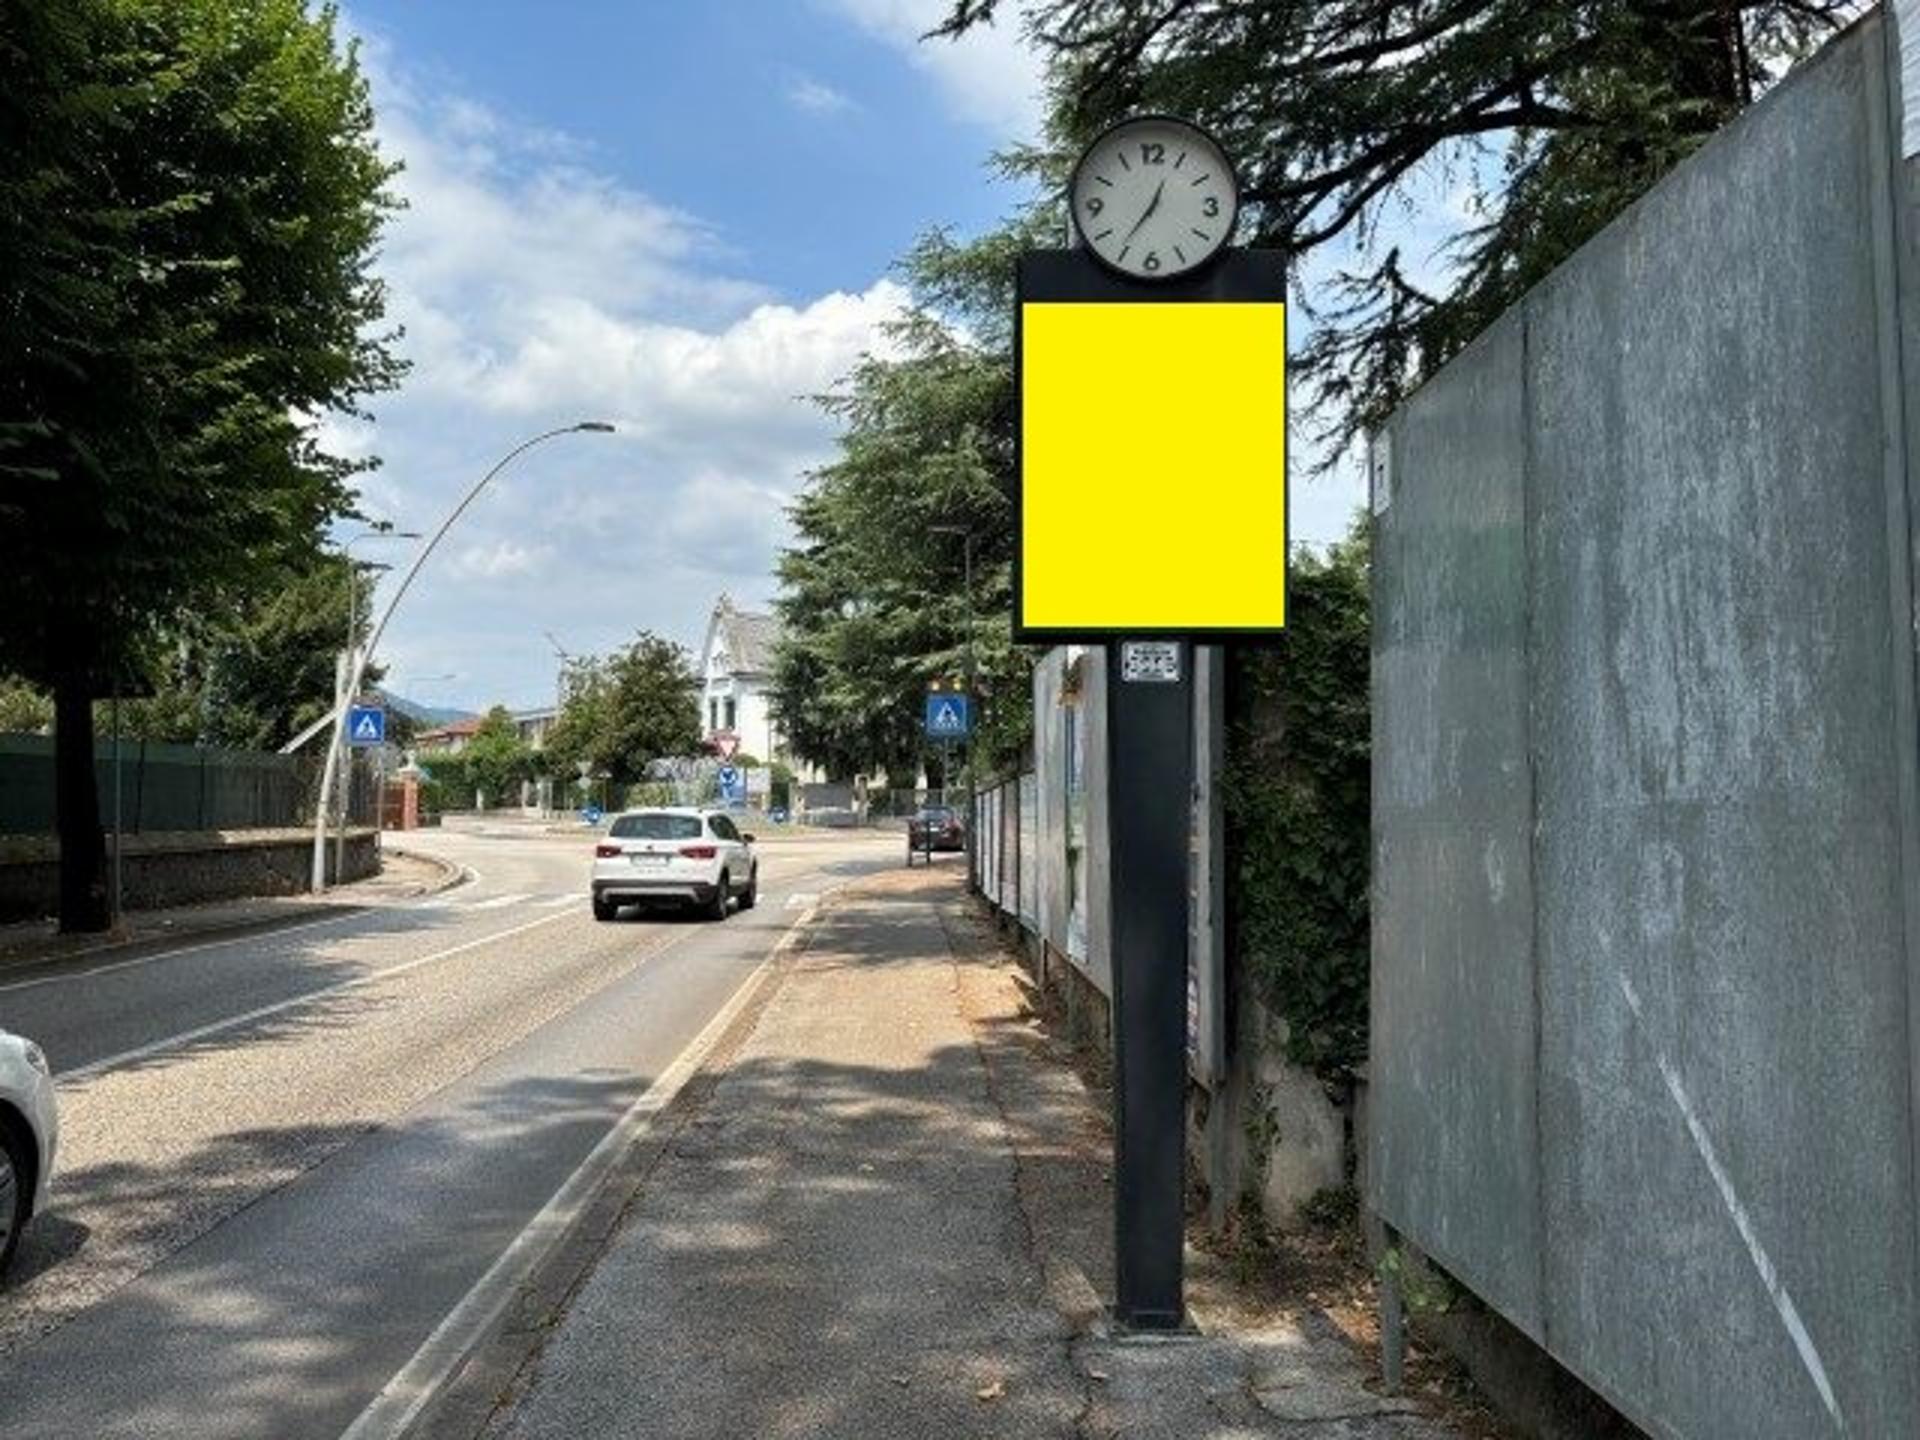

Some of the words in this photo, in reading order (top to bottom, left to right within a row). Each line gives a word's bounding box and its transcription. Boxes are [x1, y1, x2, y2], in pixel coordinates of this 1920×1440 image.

[1140, 143, 1166, 166] 12
[1085, 197, 1105, 219] 9
[1203, 197, 1219, 218] 3
[1143, 252, 1161, 271] 6
